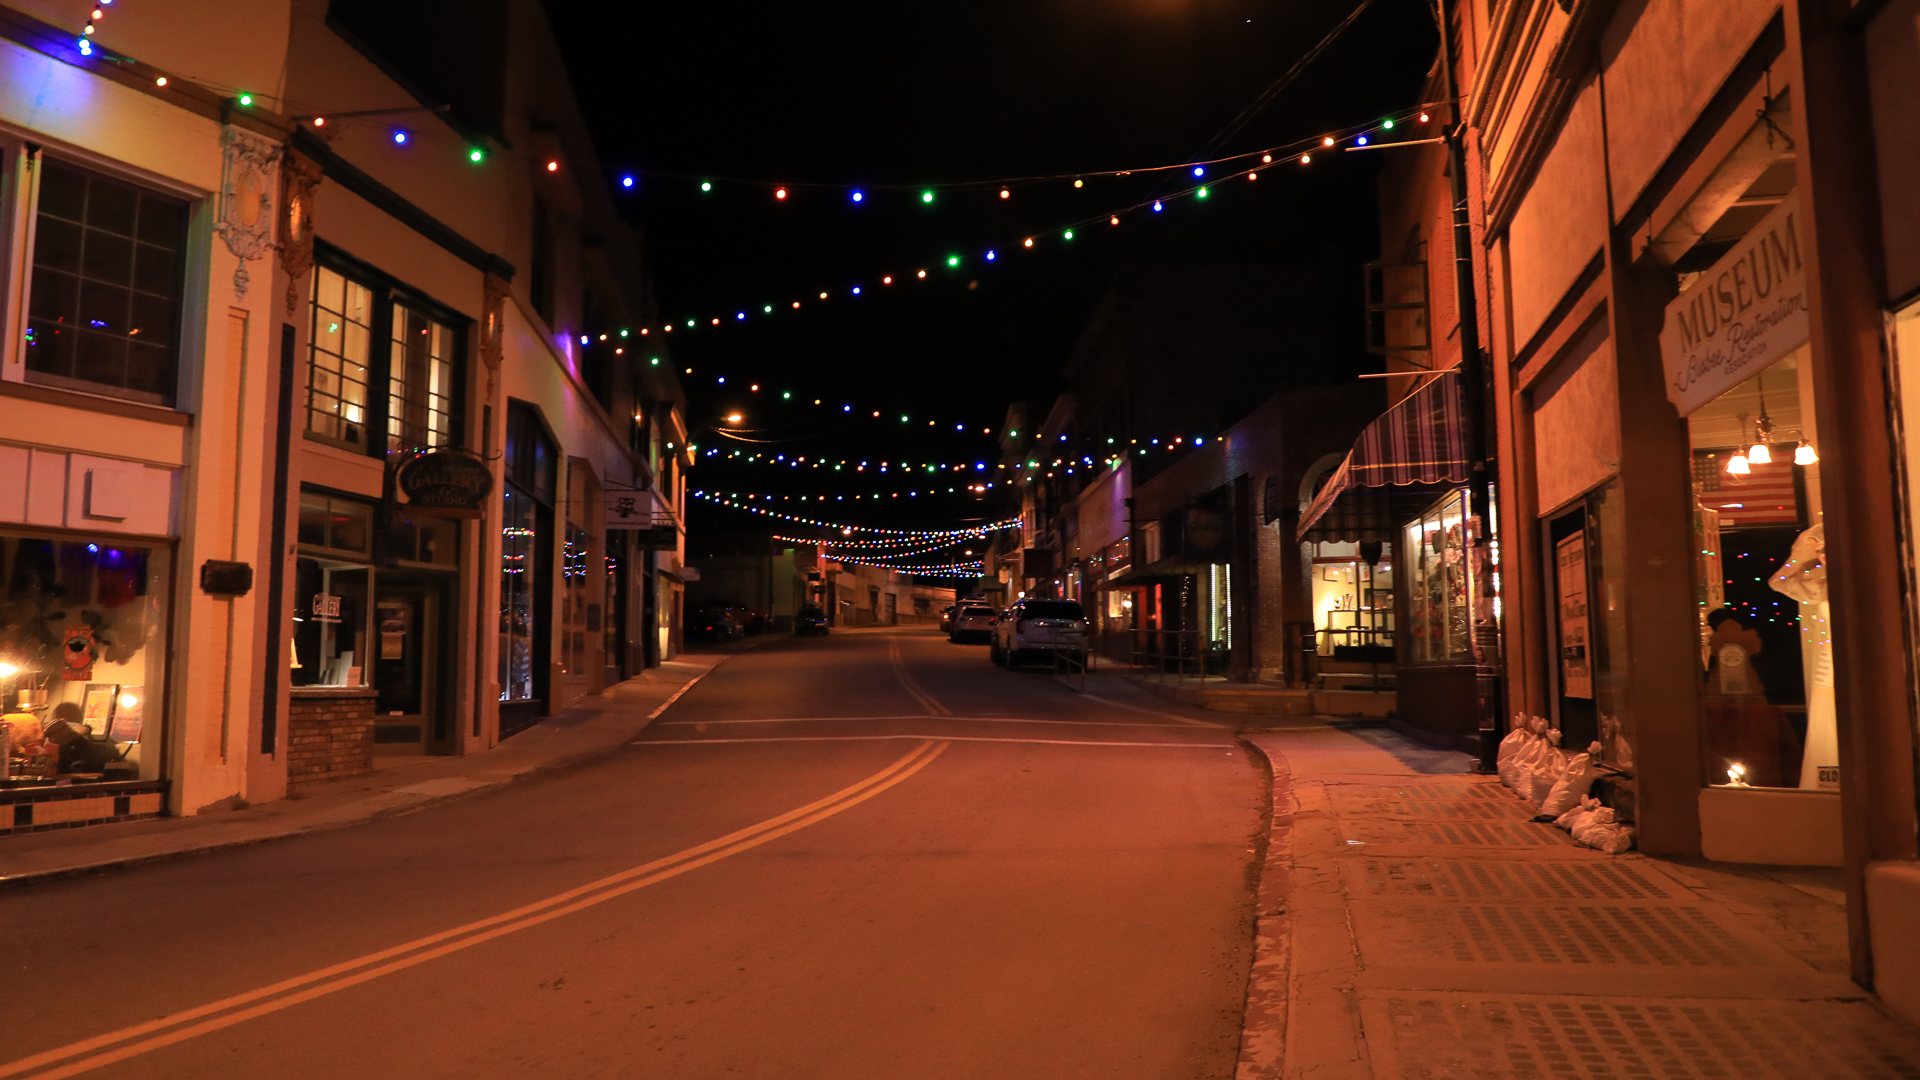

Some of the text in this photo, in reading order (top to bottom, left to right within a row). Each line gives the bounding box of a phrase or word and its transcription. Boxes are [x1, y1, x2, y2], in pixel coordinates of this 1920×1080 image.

[1677, 213, 1803, 355] MUSEUM
[1726, 293, 1809, 364] Restoration
[408, 471, 485, 494] GALLERY
[421, 494, 467, 505] STUDIO
[312, 593, 342, 617] GALLERY
